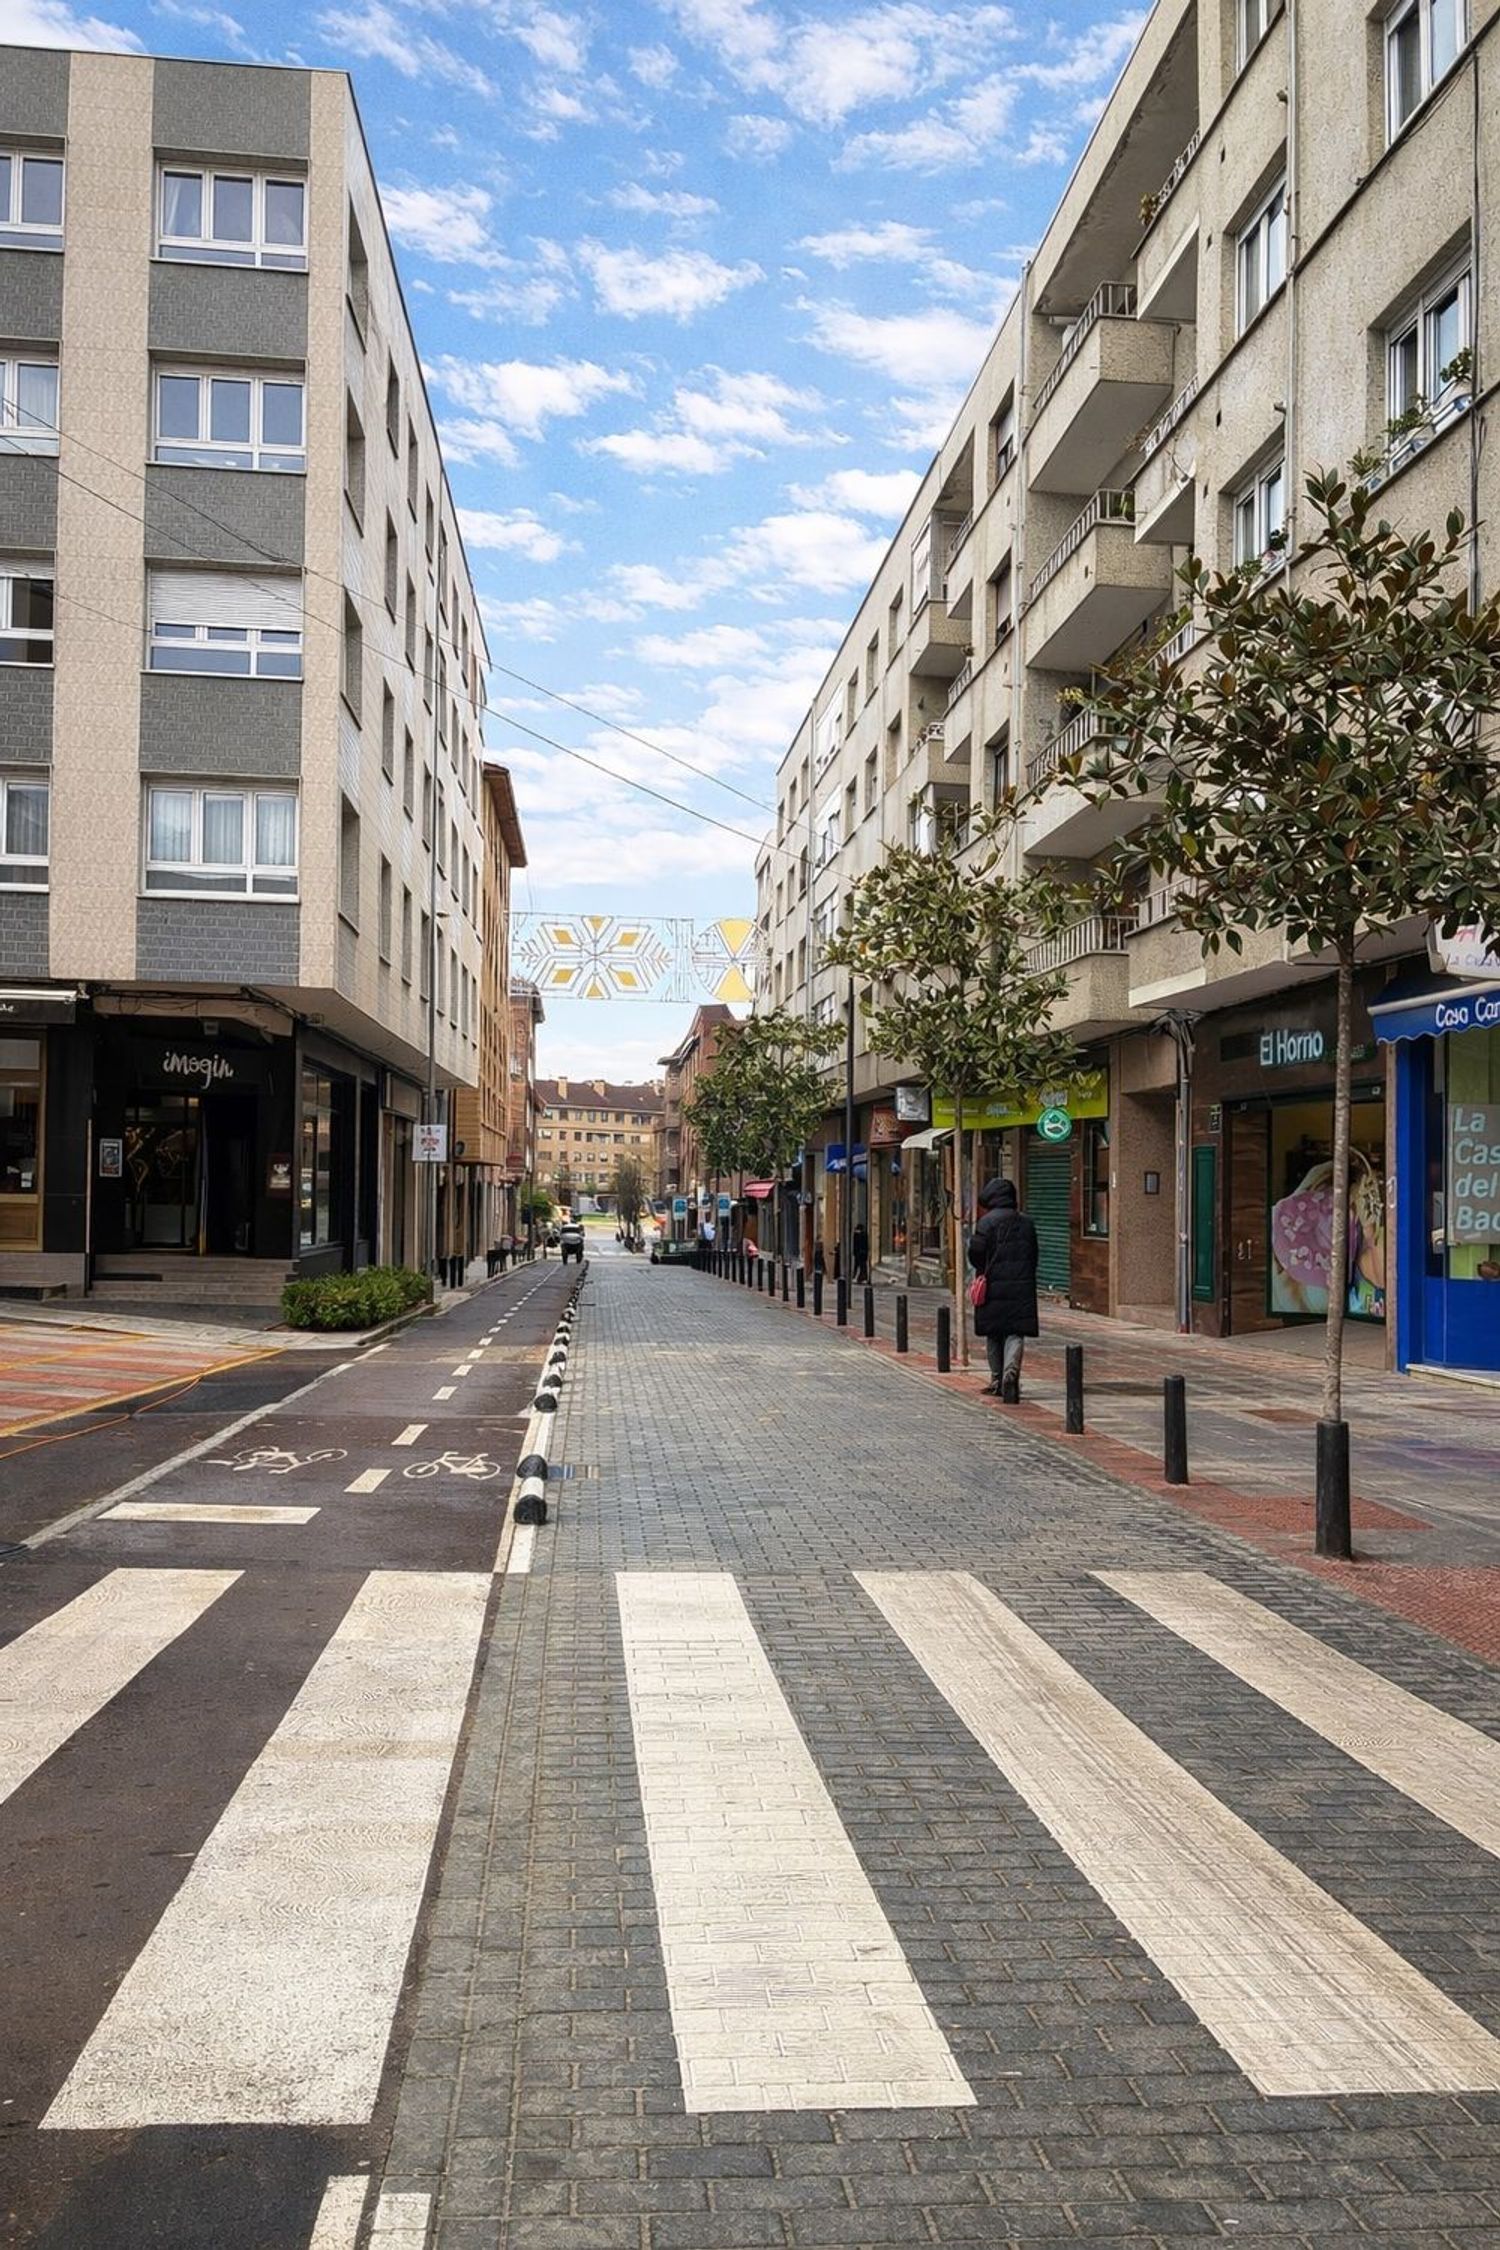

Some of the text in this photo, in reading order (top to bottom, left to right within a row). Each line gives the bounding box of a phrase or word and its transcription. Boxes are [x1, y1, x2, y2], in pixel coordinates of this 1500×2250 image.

[1259, 1032, 1273, 1066] El
[1276, 1029, 1324, 1064] Horno
[1454, 1107, 1486, 1133] La
[1454, 1137, 1500, 1165] Cas
[1455, 1171, 1498, 1198] del
